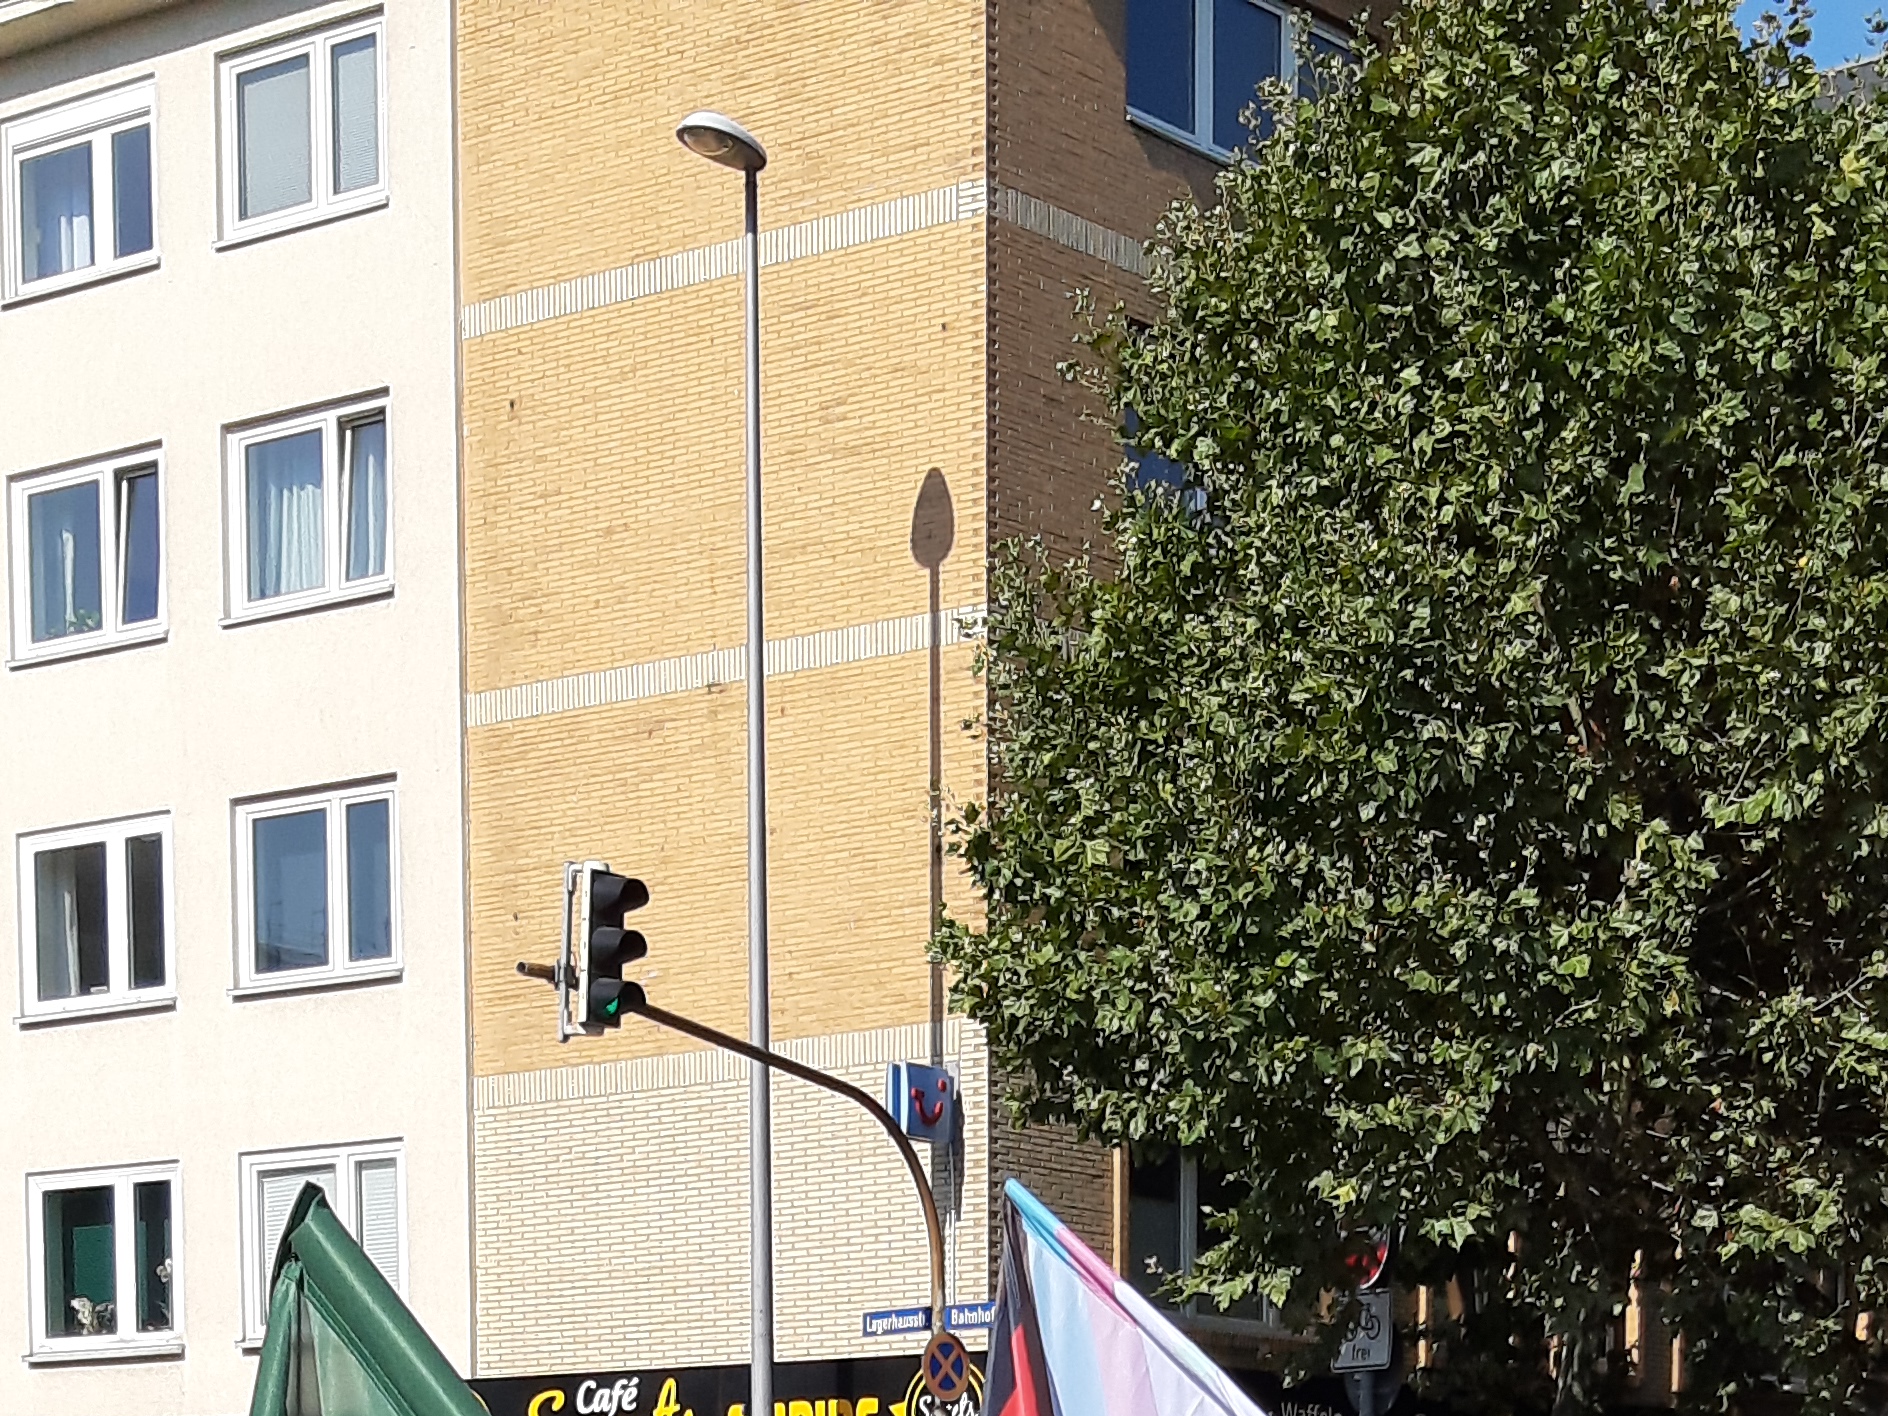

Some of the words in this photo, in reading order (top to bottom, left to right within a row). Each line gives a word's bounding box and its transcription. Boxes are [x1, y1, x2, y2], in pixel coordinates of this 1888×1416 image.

[866, 1313, 929, 1336] Lagerhausstr.
[951, 1304, 996, 1327] Bahnhof
[1351, 1347, 1371, 1361] frei
